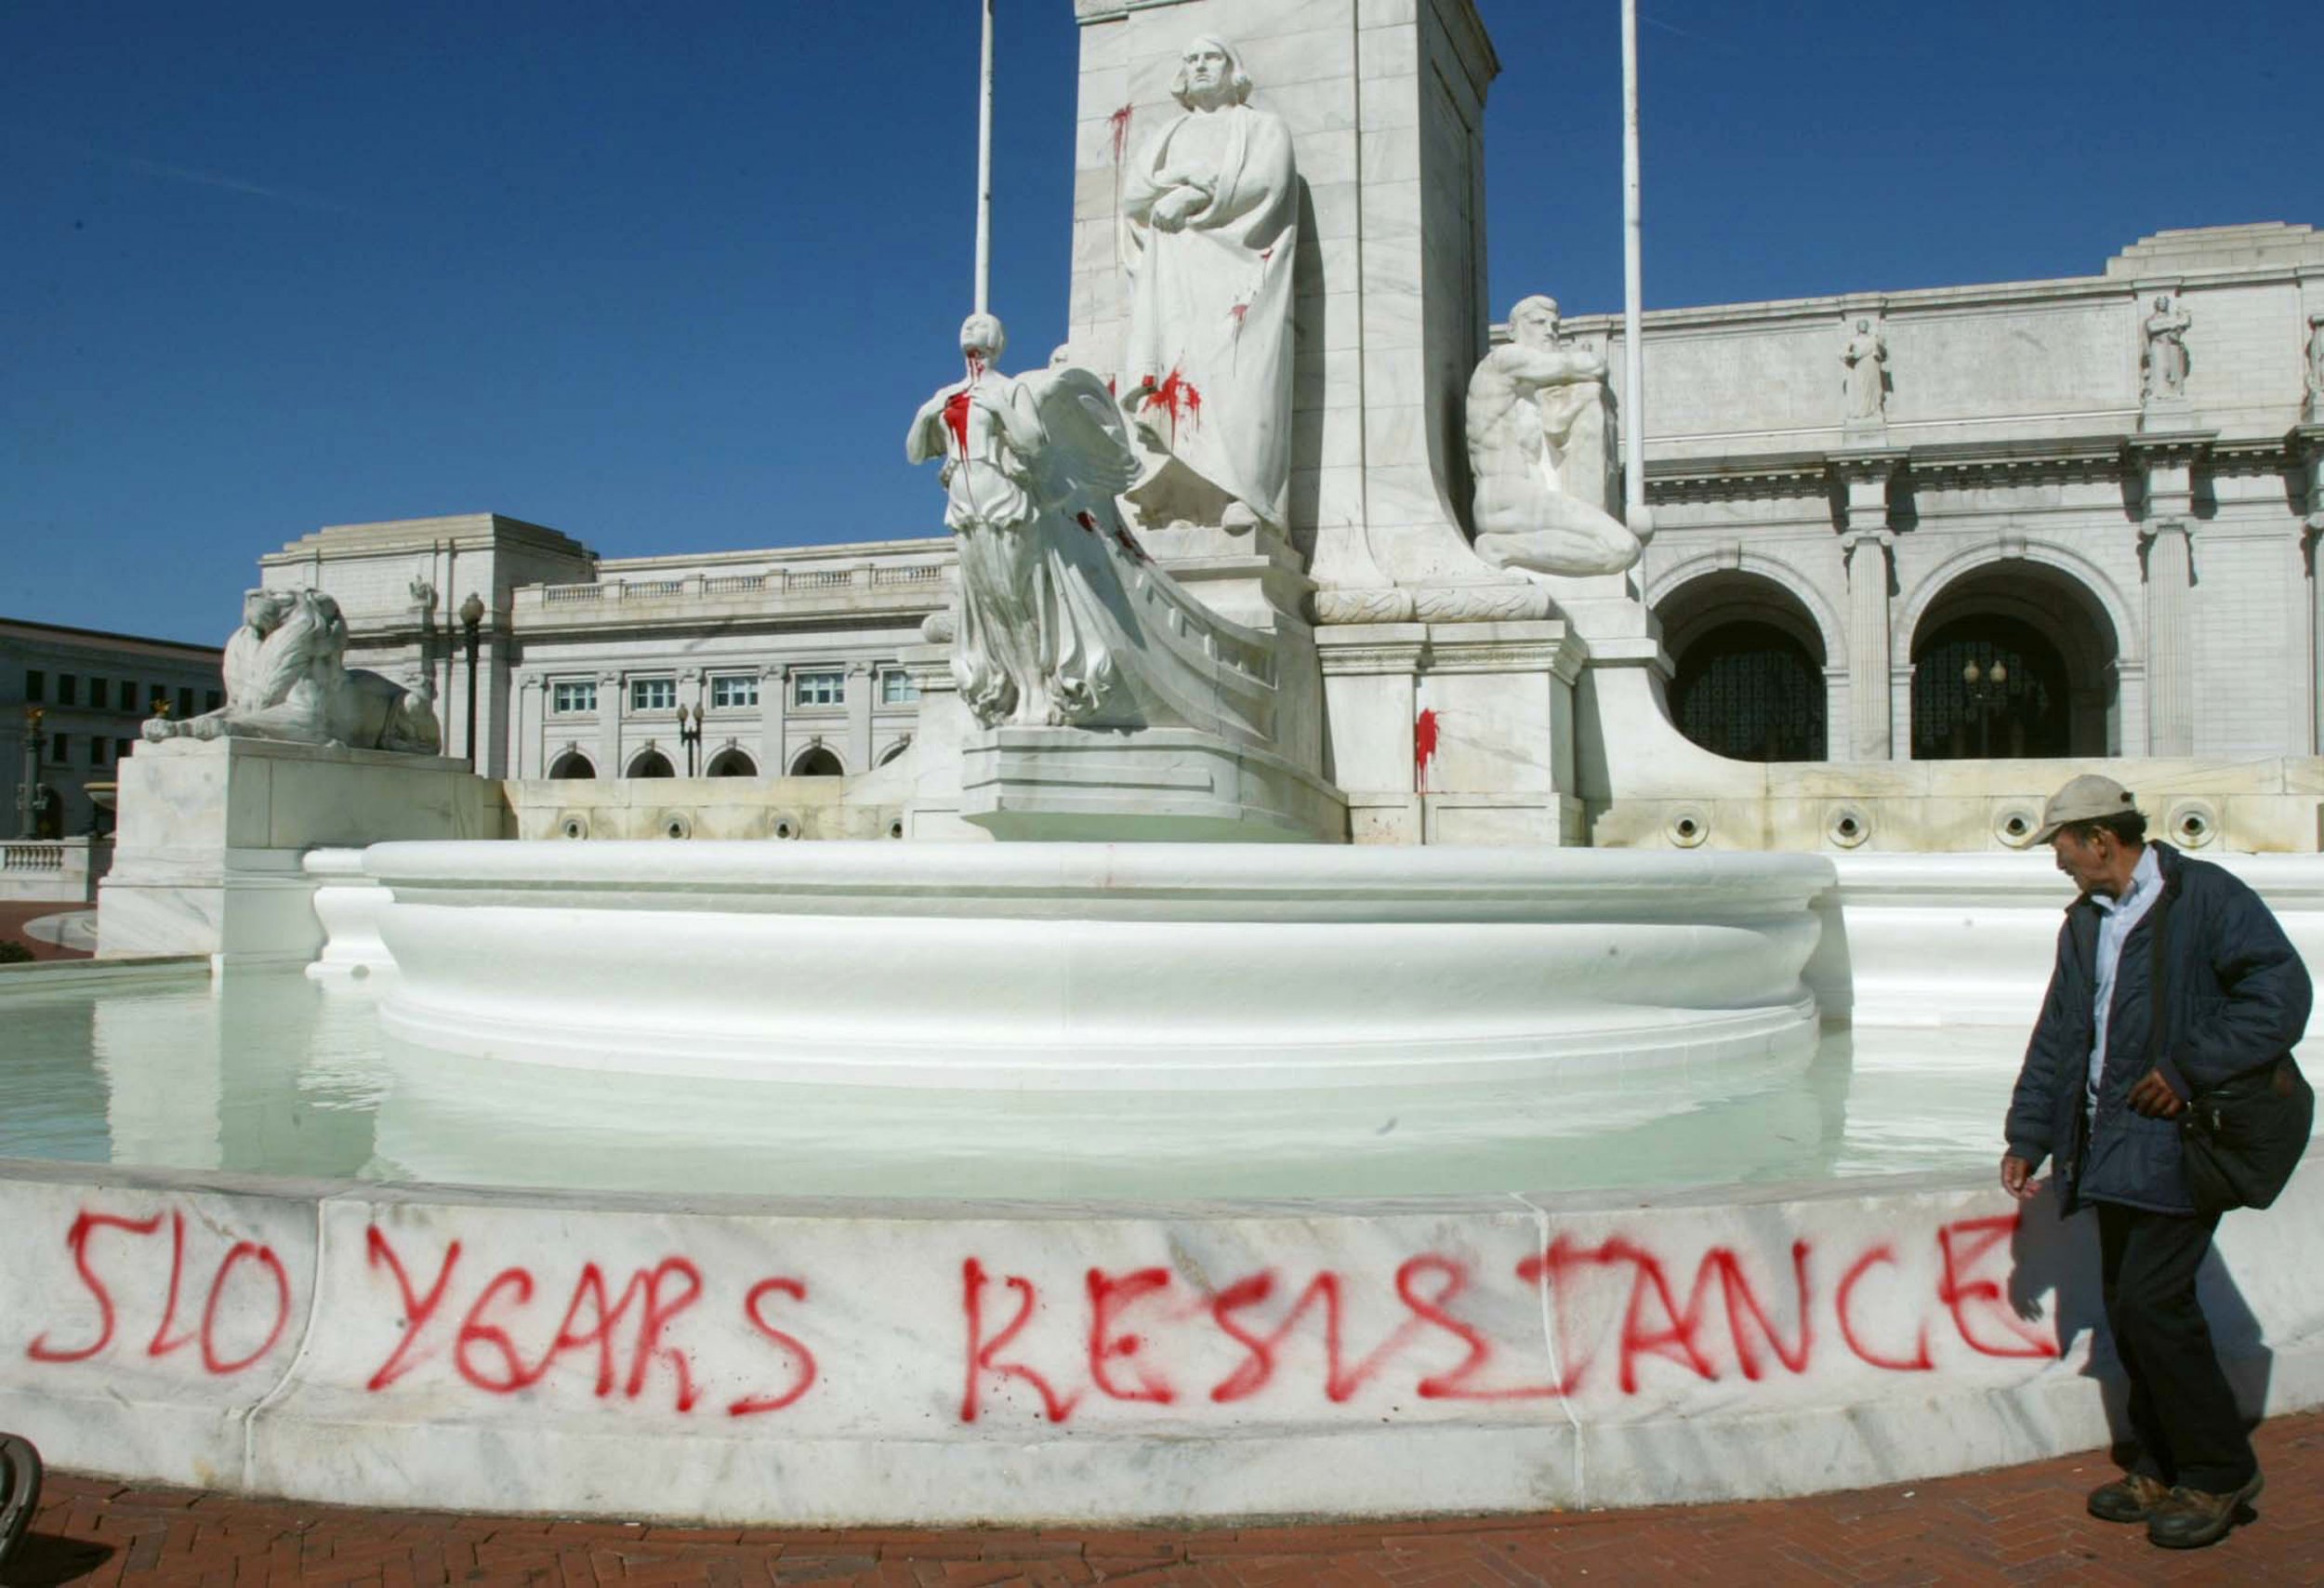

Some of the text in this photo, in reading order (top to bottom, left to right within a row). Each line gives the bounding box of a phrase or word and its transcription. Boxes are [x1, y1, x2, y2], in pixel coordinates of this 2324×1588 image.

[29, 1210, 2062, 1424] 510 YEARS RESISTANCE
